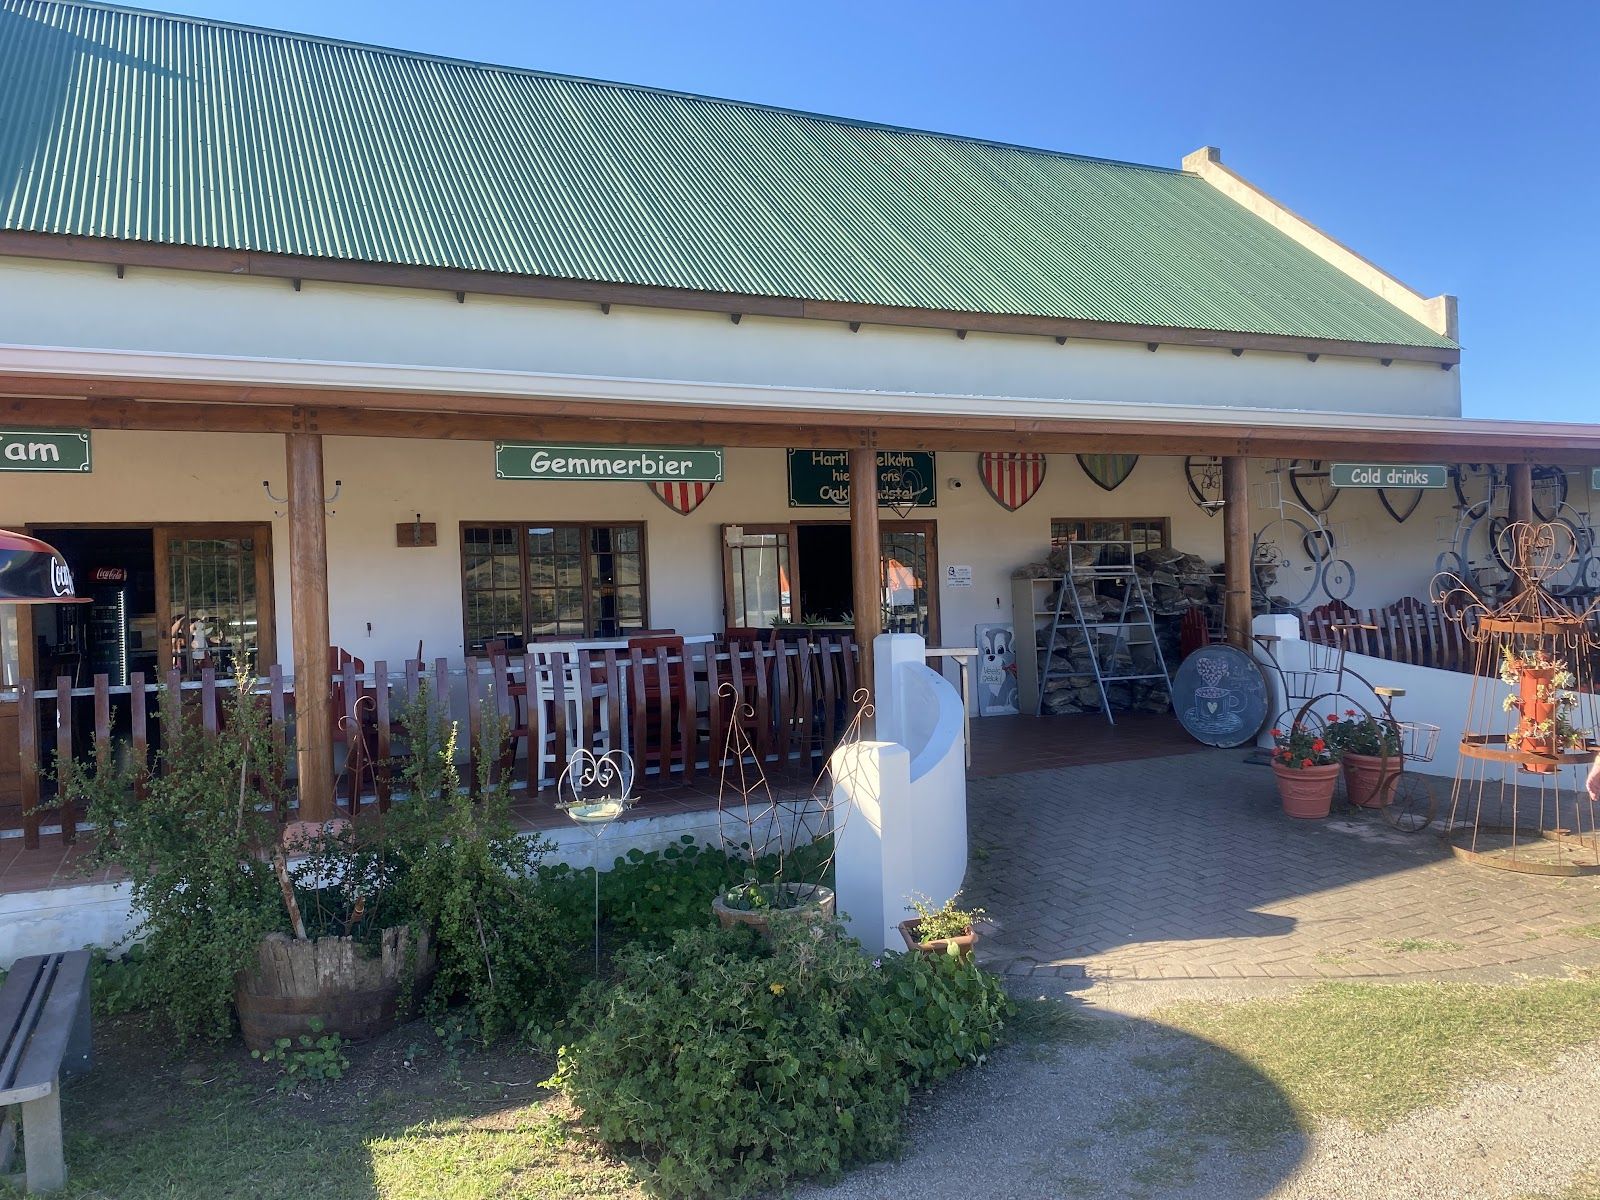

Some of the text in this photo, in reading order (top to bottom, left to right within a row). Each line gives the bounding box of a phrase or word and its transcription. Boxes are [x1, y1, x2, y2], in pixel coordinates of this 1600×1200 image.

[0, 436, 59, 461] am
[530, 451, 693, 475] Gemmerbier
[812, 452, 914, 467] Hartl elkom
[832, 469, 900, 482] hie ons
[1351, 468, 1429, 485] Cold drinks
[820, 486, 913, 500] Oak dstal
[51, 556, 75, 597] Coca
